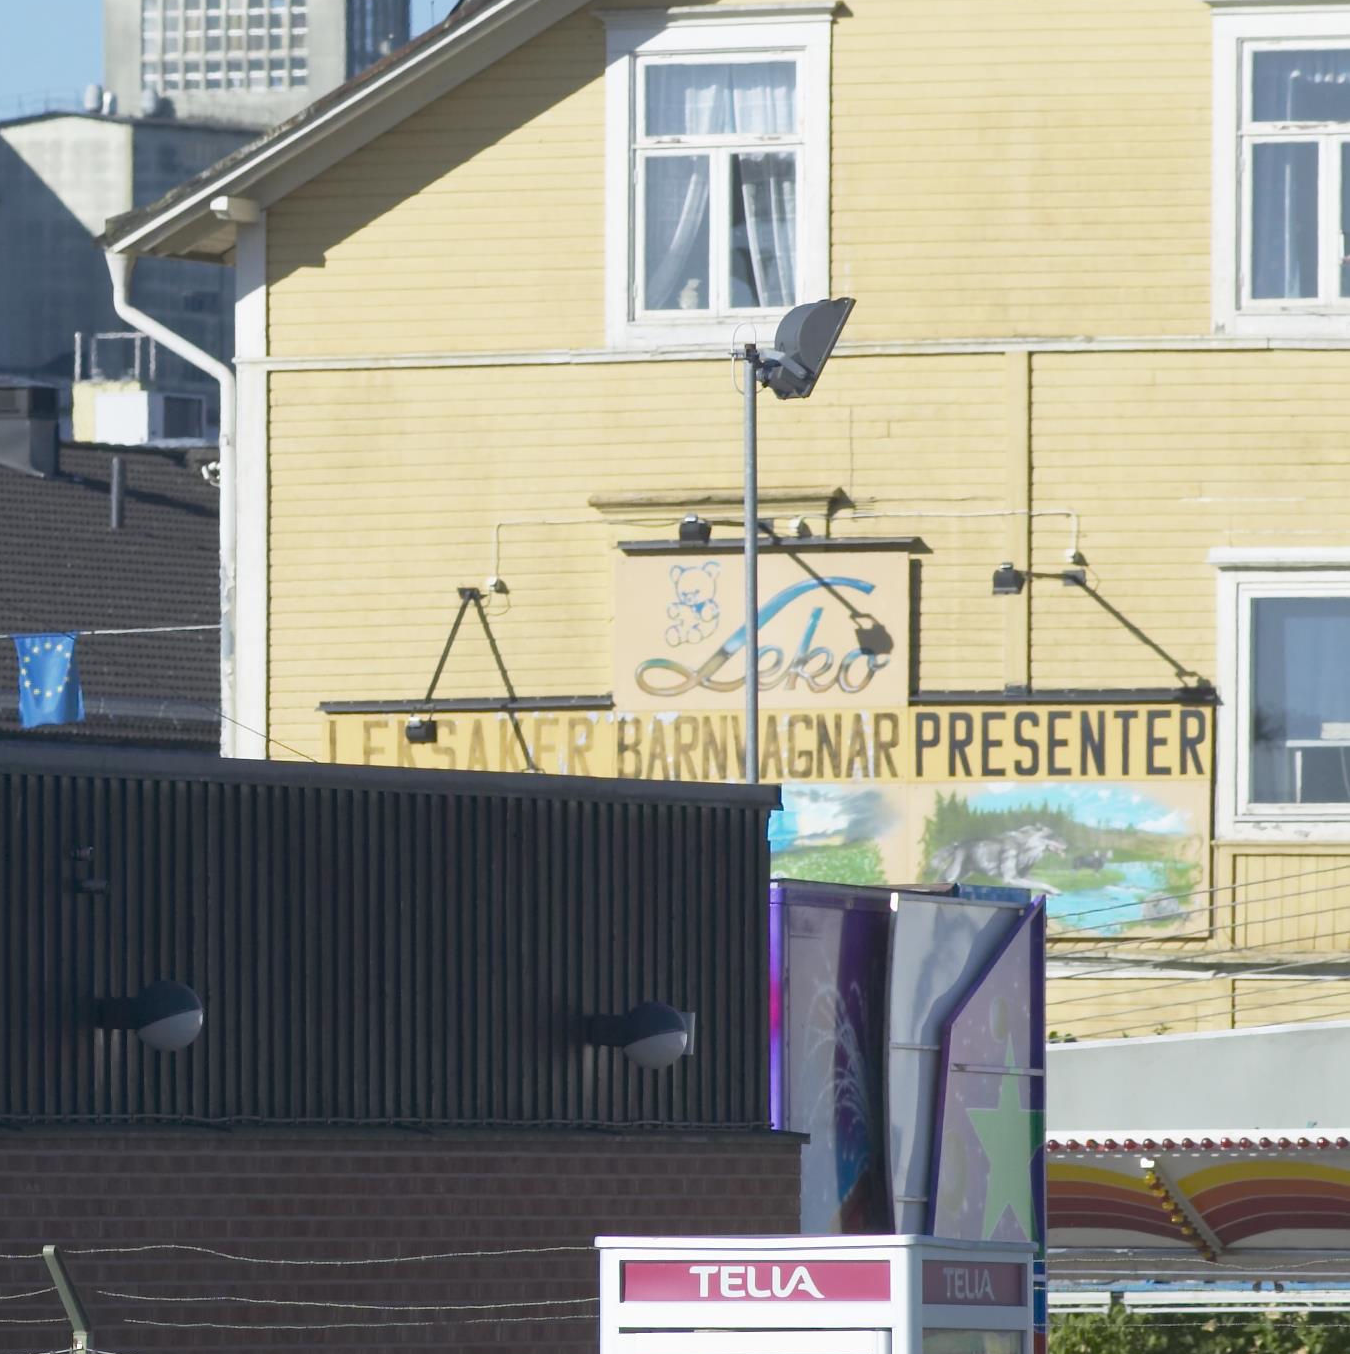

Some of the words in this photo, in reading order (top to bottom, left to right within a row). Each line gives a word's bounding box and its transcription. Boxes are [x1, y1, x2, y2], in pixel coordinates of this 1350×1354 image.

[634, 576, 890, 697] Leko
[915, 709, 1207, 778] PRESENTER
[689, 1265, 825, 1299] TELIA
[942, 1267, 996, 1301] TELIA
